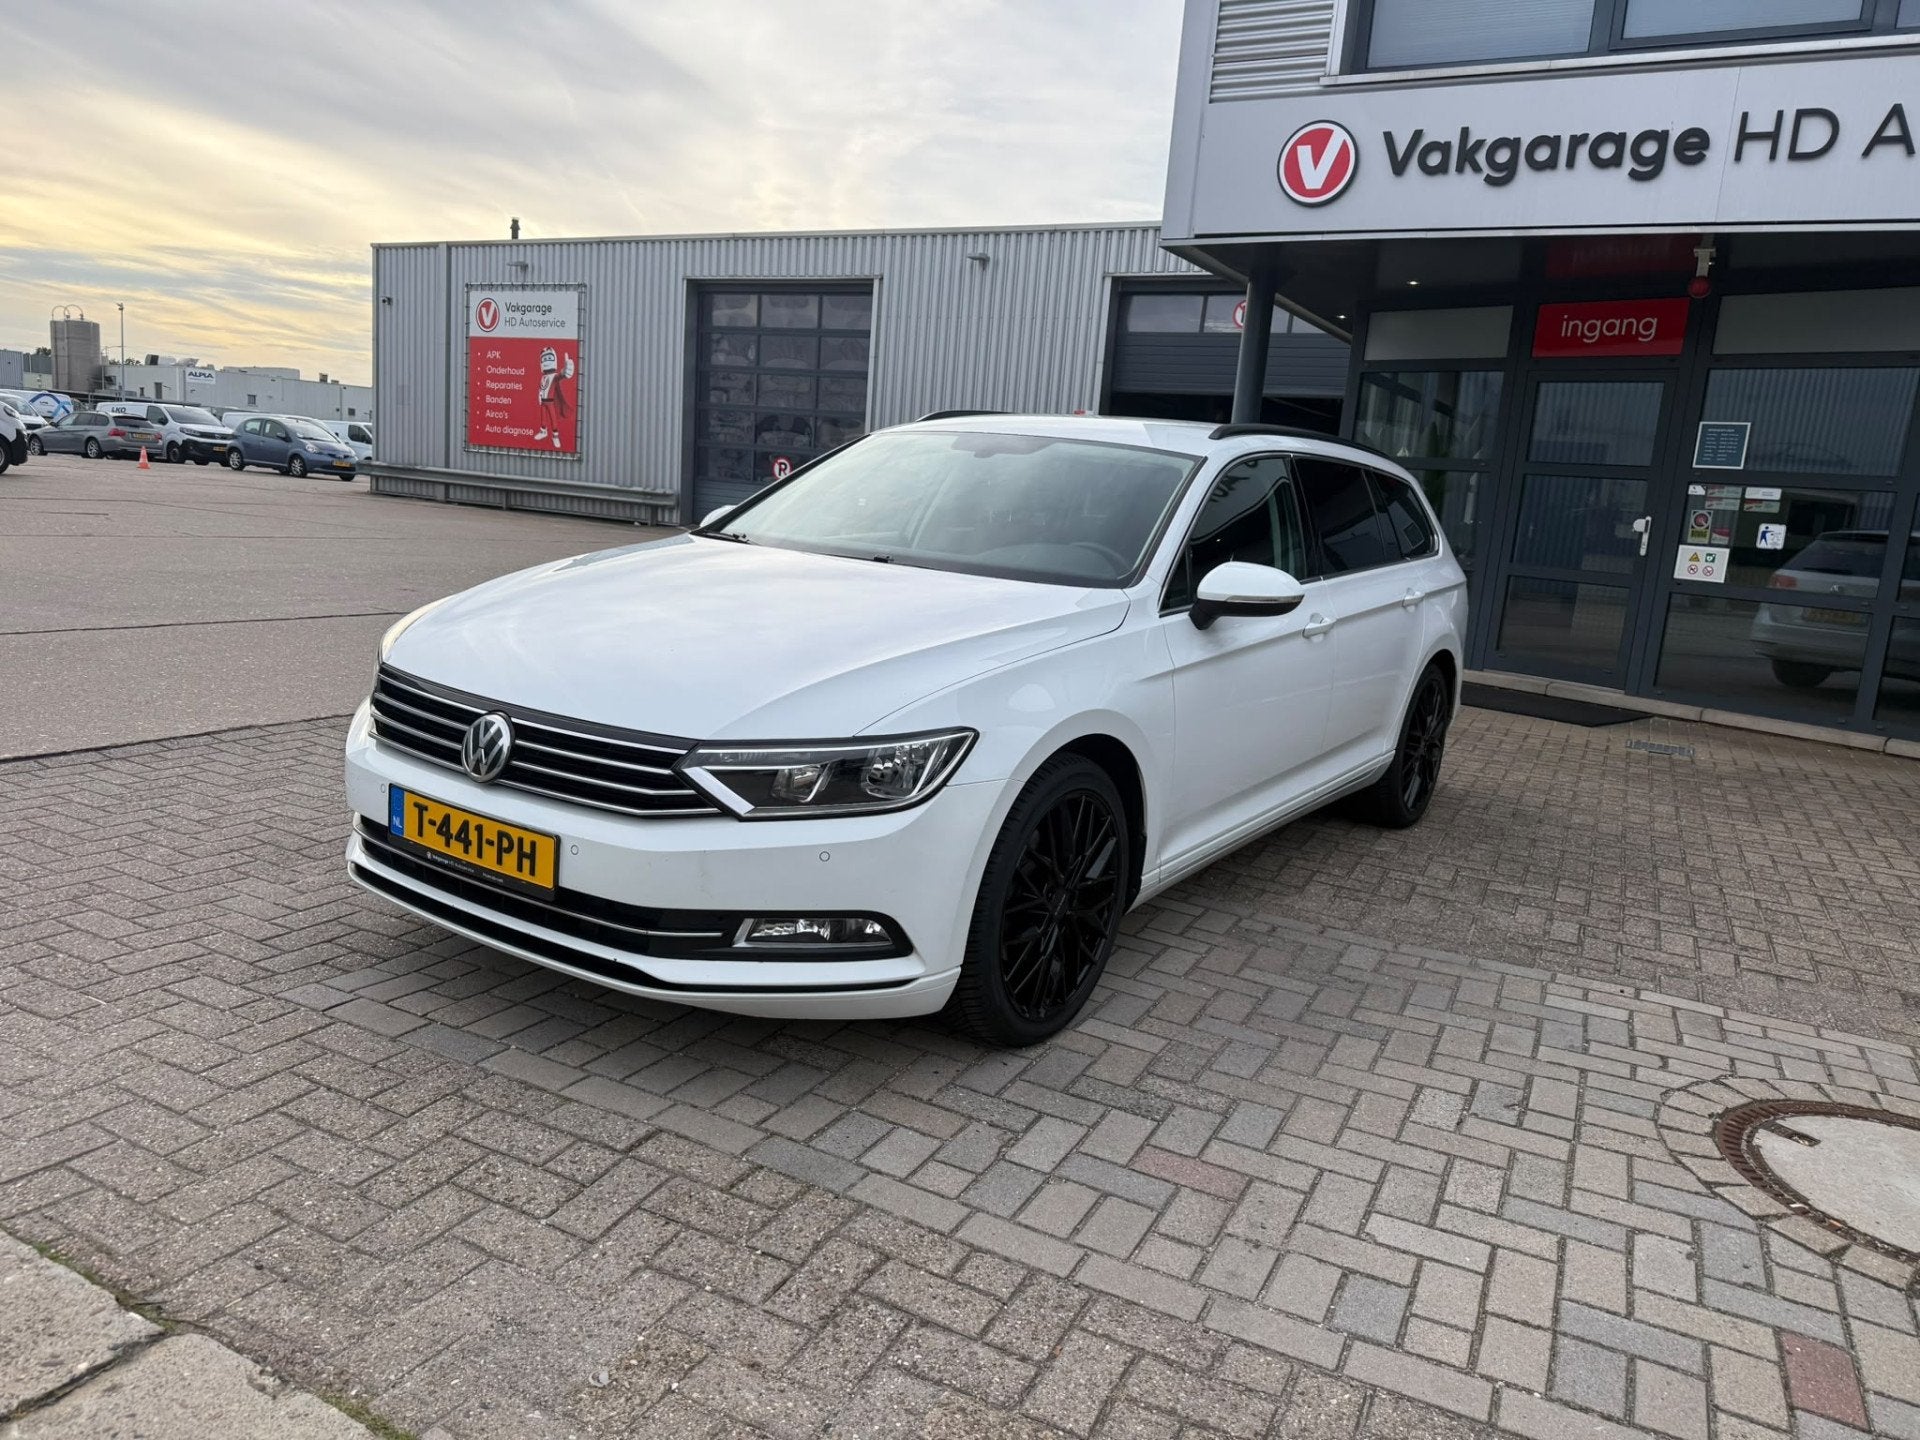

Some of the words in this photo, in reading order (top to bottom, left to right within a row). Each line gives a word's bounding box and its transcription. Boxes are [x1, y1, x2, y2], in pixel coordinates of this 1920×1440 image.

[1382, 122, 1711, 187] Vakgarage
[1733, 106, 1840, 162] HD
[1861, 102, 1916, 158] A
[505, 302, 552, 315] Vakgarage
[505, 317, 517, 327] HD
[519, 317, 566, 328] Autoservice
[1561, 315, 1658, 343] ingang
[486, 350, 501, 359] APK
[486, 365, 525, 376] Onderhoud
[485, 380, 523, 391] Reparaties
[485, 395, 511, 405] Banden
[485, 409, 508, 419] Airco's
[485, 424, 500, 434] Auto
[502, 427, 534, 436] diagnose
[392, 814, 403, 829] NL
[413, 801, 537, 877] T-441-PH
